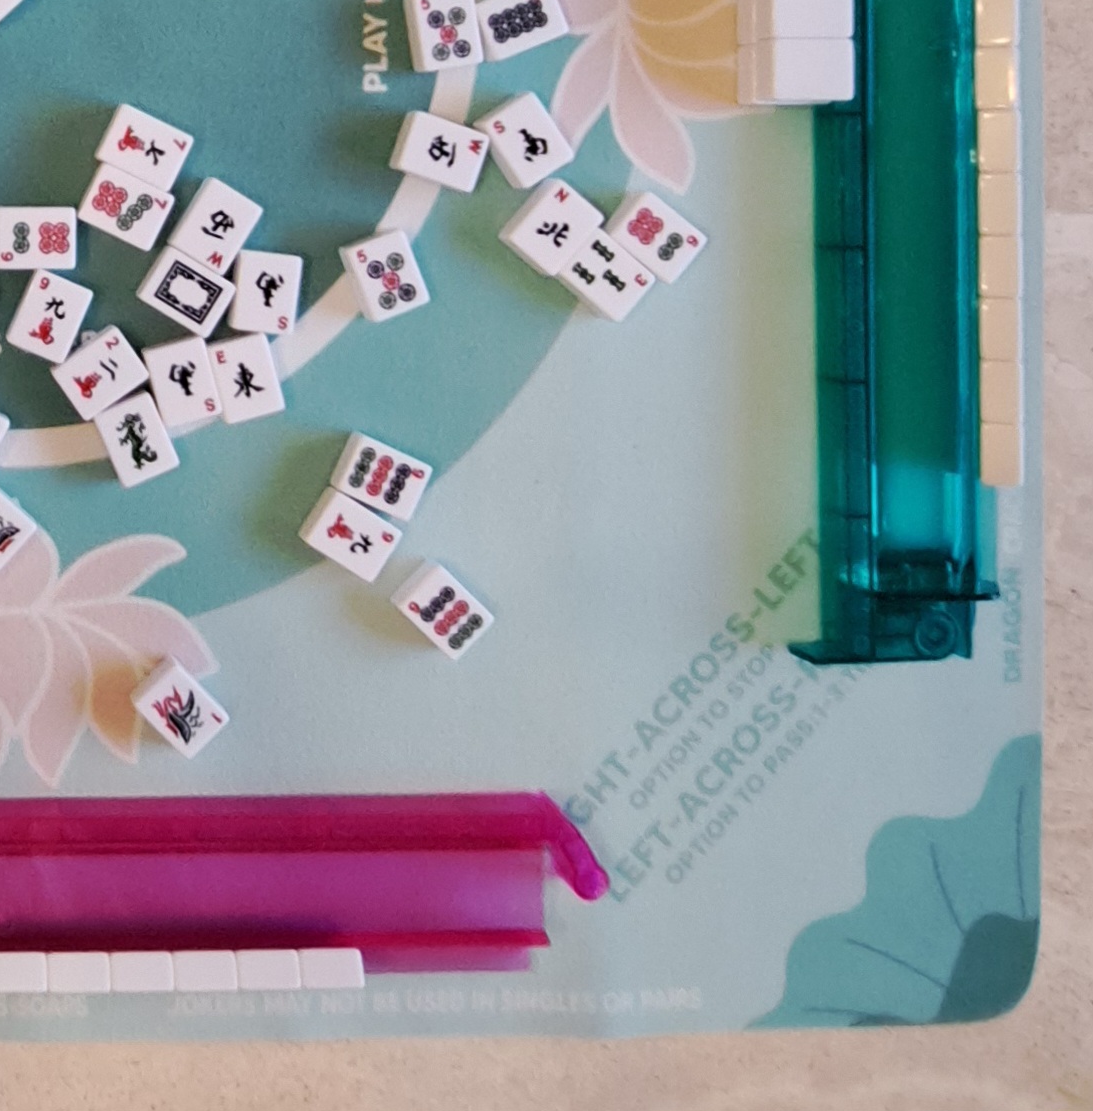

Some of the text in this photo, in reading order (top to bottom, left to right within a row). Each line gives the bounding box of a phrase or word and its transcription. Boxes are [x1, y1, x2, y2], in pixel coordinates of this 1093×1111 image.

[362, 12, 389, 94] PLAY
[492, 120, 504, 134] S
[173, 139, 187, 151] 7
[428, 136, 456, 167] 西
[468, 140, 481, 154] W
[519, 128, 548, 162] 南
[555, 189, 568, 203] N
[154, 198, 168, 210] 7
[201, 210, 235, 240] 西
[536, 222, 570, 248] 北
[686, 235, 699, 247] 6
[0, 252, 13, 262] 6
[208, 252, 223, 267] W
[356, 249, 367, 263] 5
[39, 277, 49, 290] 9
[634, 274, 646, 287] 3
[255, 271, 284, 308] 南
[277, 316, 288, 330] S
[105, 338, 119, 350] 2
[216, 350, 226, 364] E
[169, 361, 196, 397] 南
[234, 363, 264, 398] 東
[204, 399, 215, 413] S
[1003, 568, 1023, 683] DRAGON
[211, 713, 222, 724] 1
[626, 641, 781, 811] OPTION TO STOP
[663, 803, 739, 885] OPTION
[735, 772, 767, 805] TO
